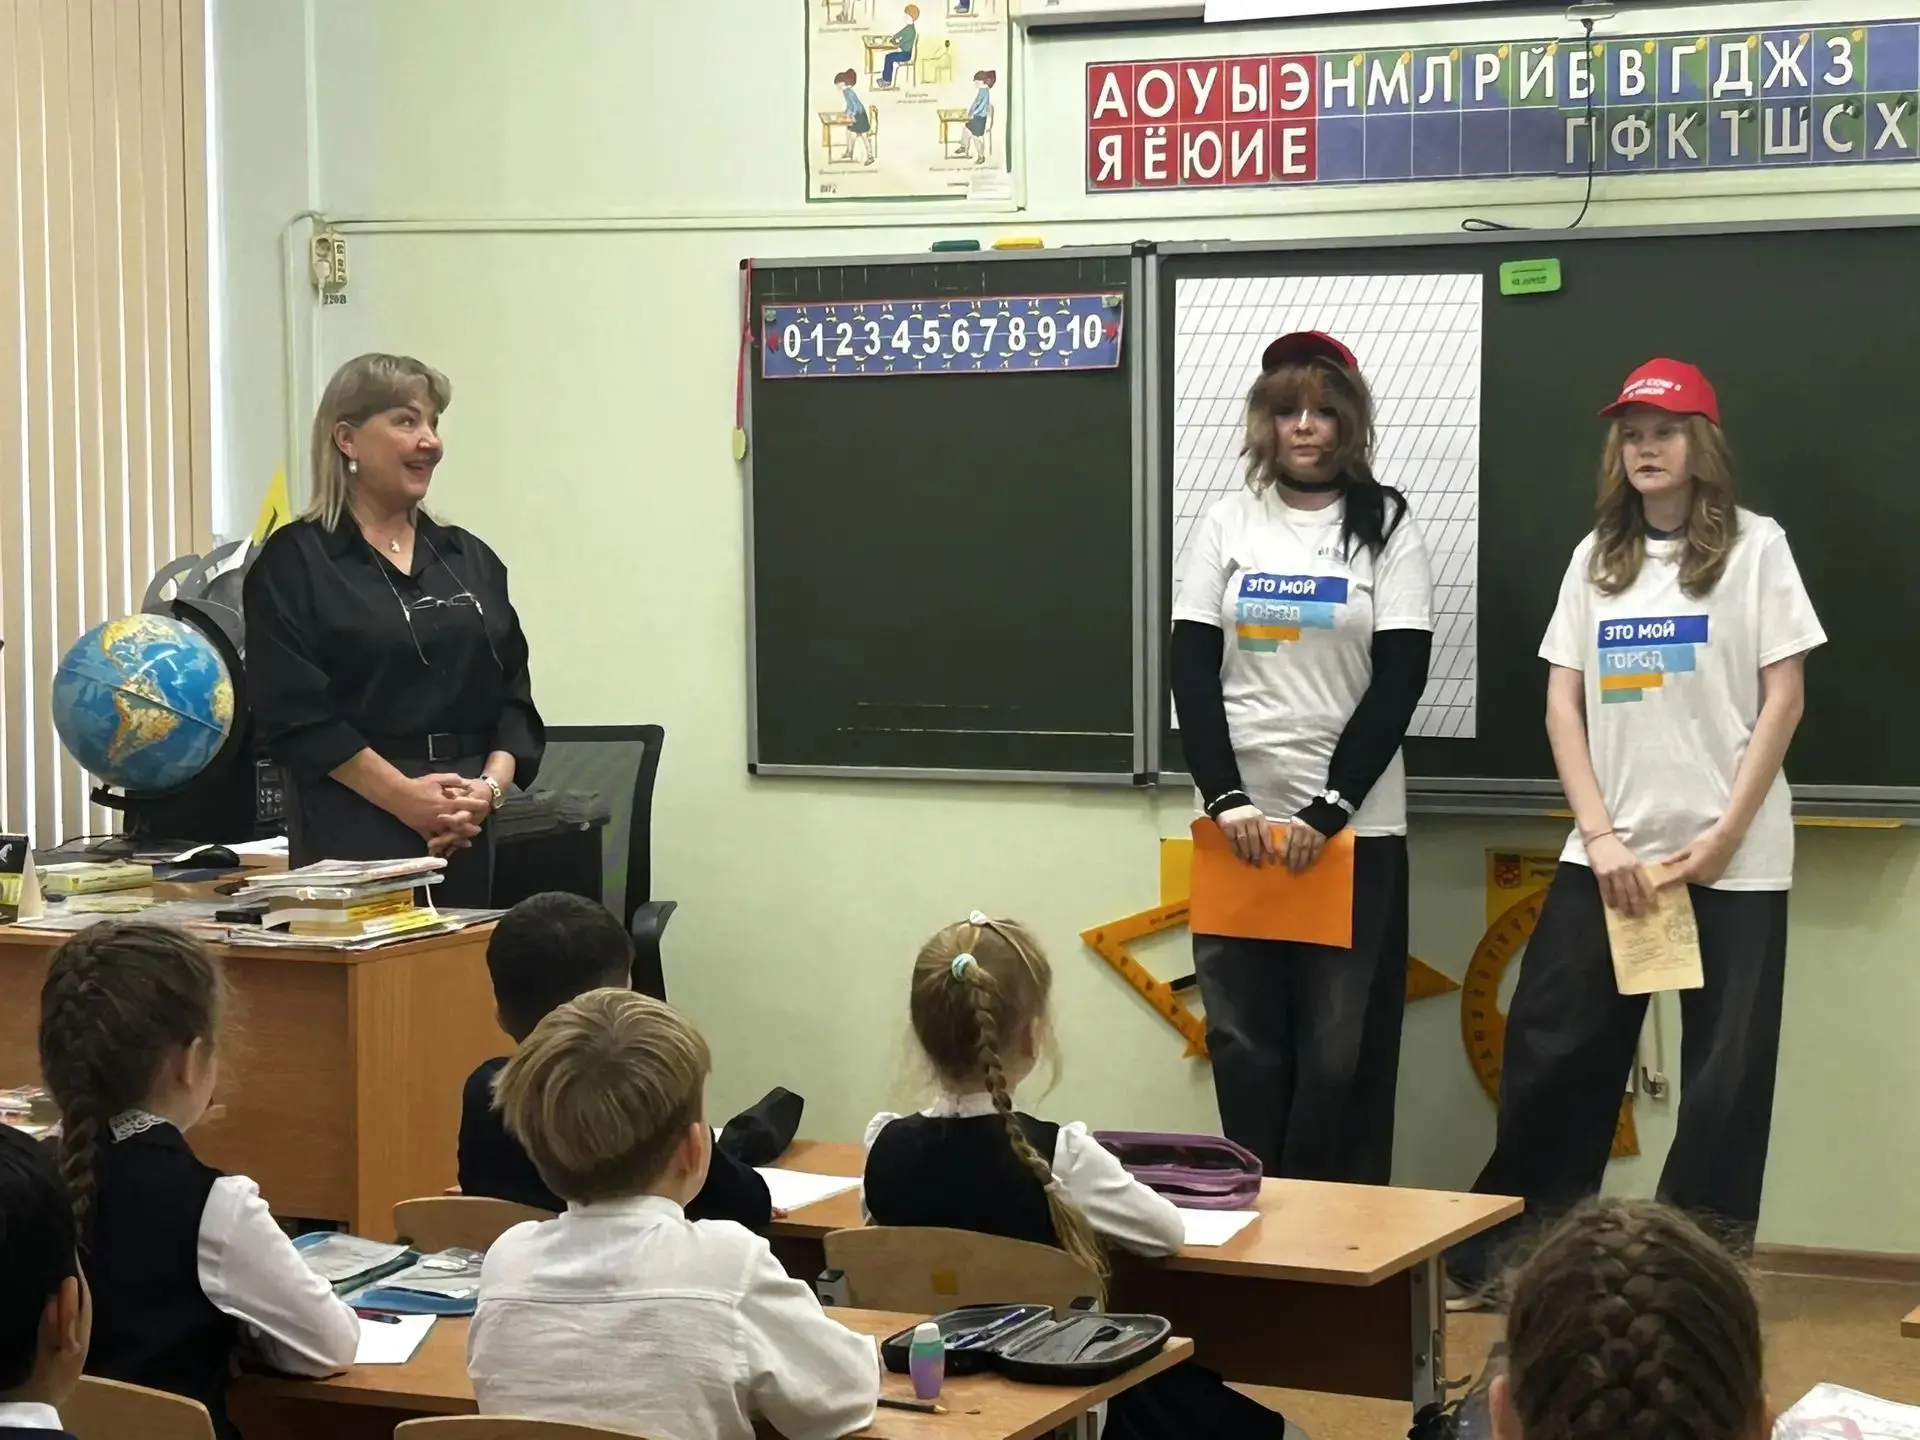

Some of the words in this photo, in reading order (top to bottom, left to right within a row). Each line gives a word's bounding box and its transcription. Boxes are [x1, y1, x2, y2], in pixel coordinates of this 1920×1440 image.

[1093, 71, 1128, 120] А
[1137, 69, 1175, 119] О
[1186, 66, 1217, 115] У
[1231, 65, 1267, 113] Ы
[1280, 62, 1309, 111] Э
[1324, 61, 1356, 108] Н
[1366, 58, 1409, 106] М
[1417, 55, 1452, 104] Л
[1475, 53, 1500, 101] Р
[1519, 45, 1554, 100] Й
[1569, 51, 1595, 100] Б
[1619, 48, 1646, 96] В
[1671, 45, 1697, 94] Г
[1712, 43, 1753, 99] Д
[1762, 39, 1809, 89] Ж
[1823, 37, 1854, 86] З
[1096, 134, 1122, 182] Я
[1144, 126, 1167, 180] Ё
[1183, 130, 1223, 179] Ю
[1231, 129, 1264, 178] И
[1282, 127, 1307, 175] Е
[1566, 116, 1596, 164] П
[1610, 114, 1652, 162] Ф
[1668, 111, 1699, 160] К
[1720, 109, 1750, 157] Т
[1764, 107, 1808, 156] Ш
[1822, 104, 1855, 153] С
[1874, 101, 1909, 152] Х
[783, 324, 801, 358] 0
[810, 323, 823, 357] 1
[836, 322, 853, 356] 2
[864, 321, 881, 355] 3
[891, 320, 911, 354] 4
[922, 319, 941, 354] 5
[952, 318, 970, 353] 6
[979, 318, 998, 351] 7
[1008, 316, 1026, 352] 8
[1037, 315, 1056, 351] 9
[1066, 314, 1102, 349] 10
[1246, 577, 1276, 593] ЭТО
[1278, 579, 1317, 595] МОЙ
[1604, 624, 1634, 640] ЭТО
[1638, 620, 1675, 639] МОЙ
[1606, 651, 1665, 670] ГОРОД
